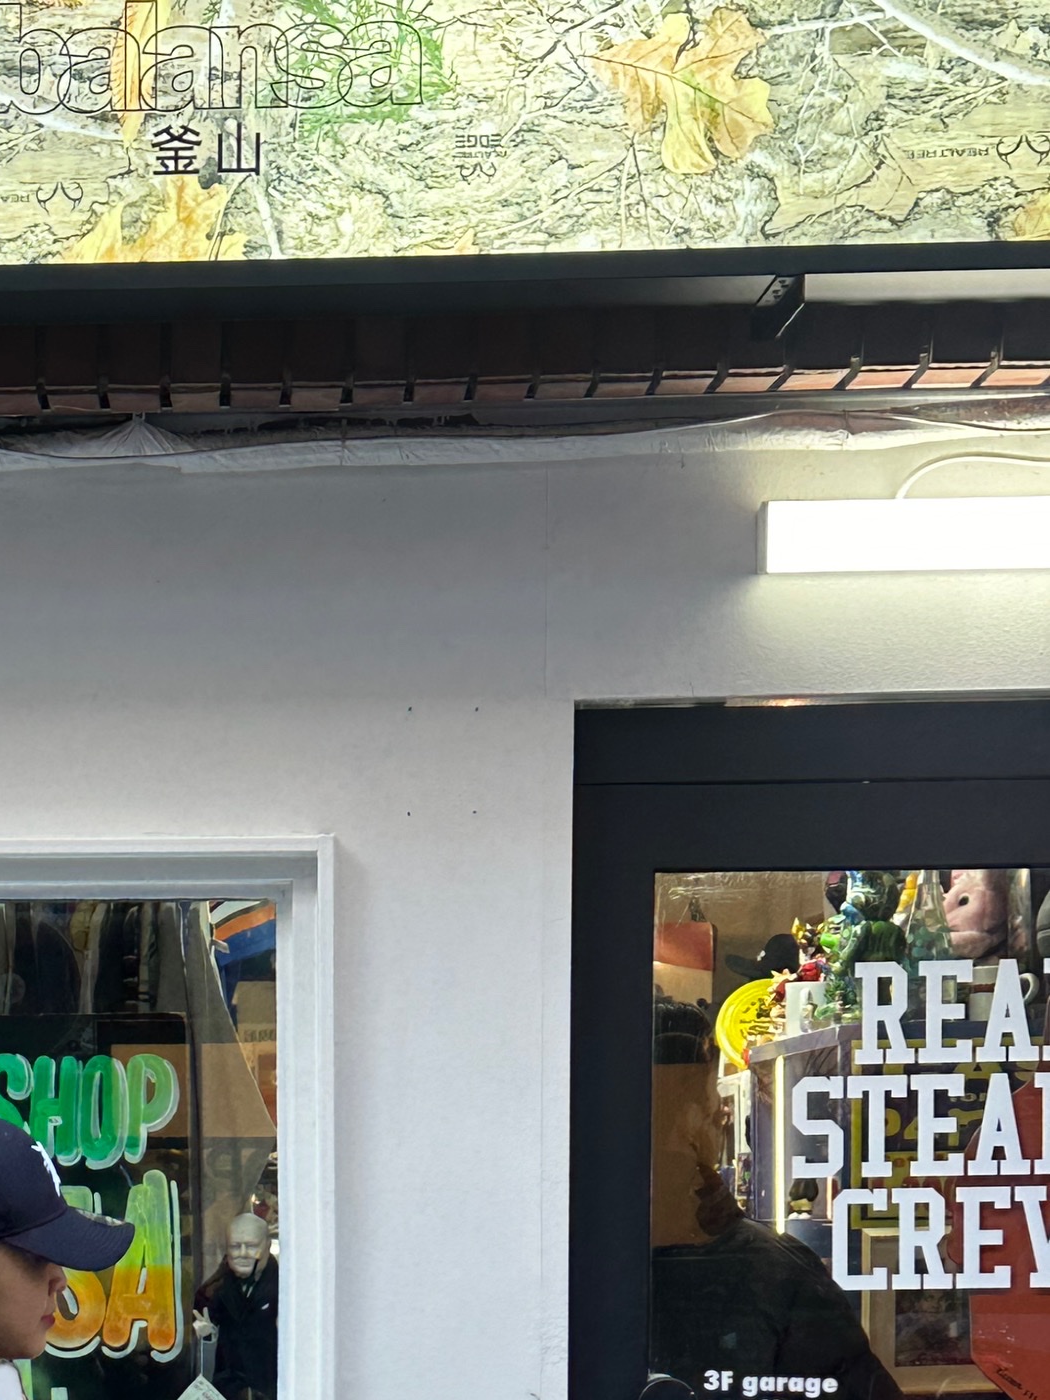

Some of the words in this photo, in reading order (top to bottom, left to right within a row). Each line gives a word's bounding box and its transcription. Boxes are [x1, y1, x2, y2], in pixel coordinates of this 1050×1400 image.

[151, 124, 263, 177] 釜山
[854, 958, 1050, 1063] REA
[792, 1072, 1050, 1180] STEA
[703, 1369, 734, 1391] 3F
[741, 1376, 839, 1398] garage
